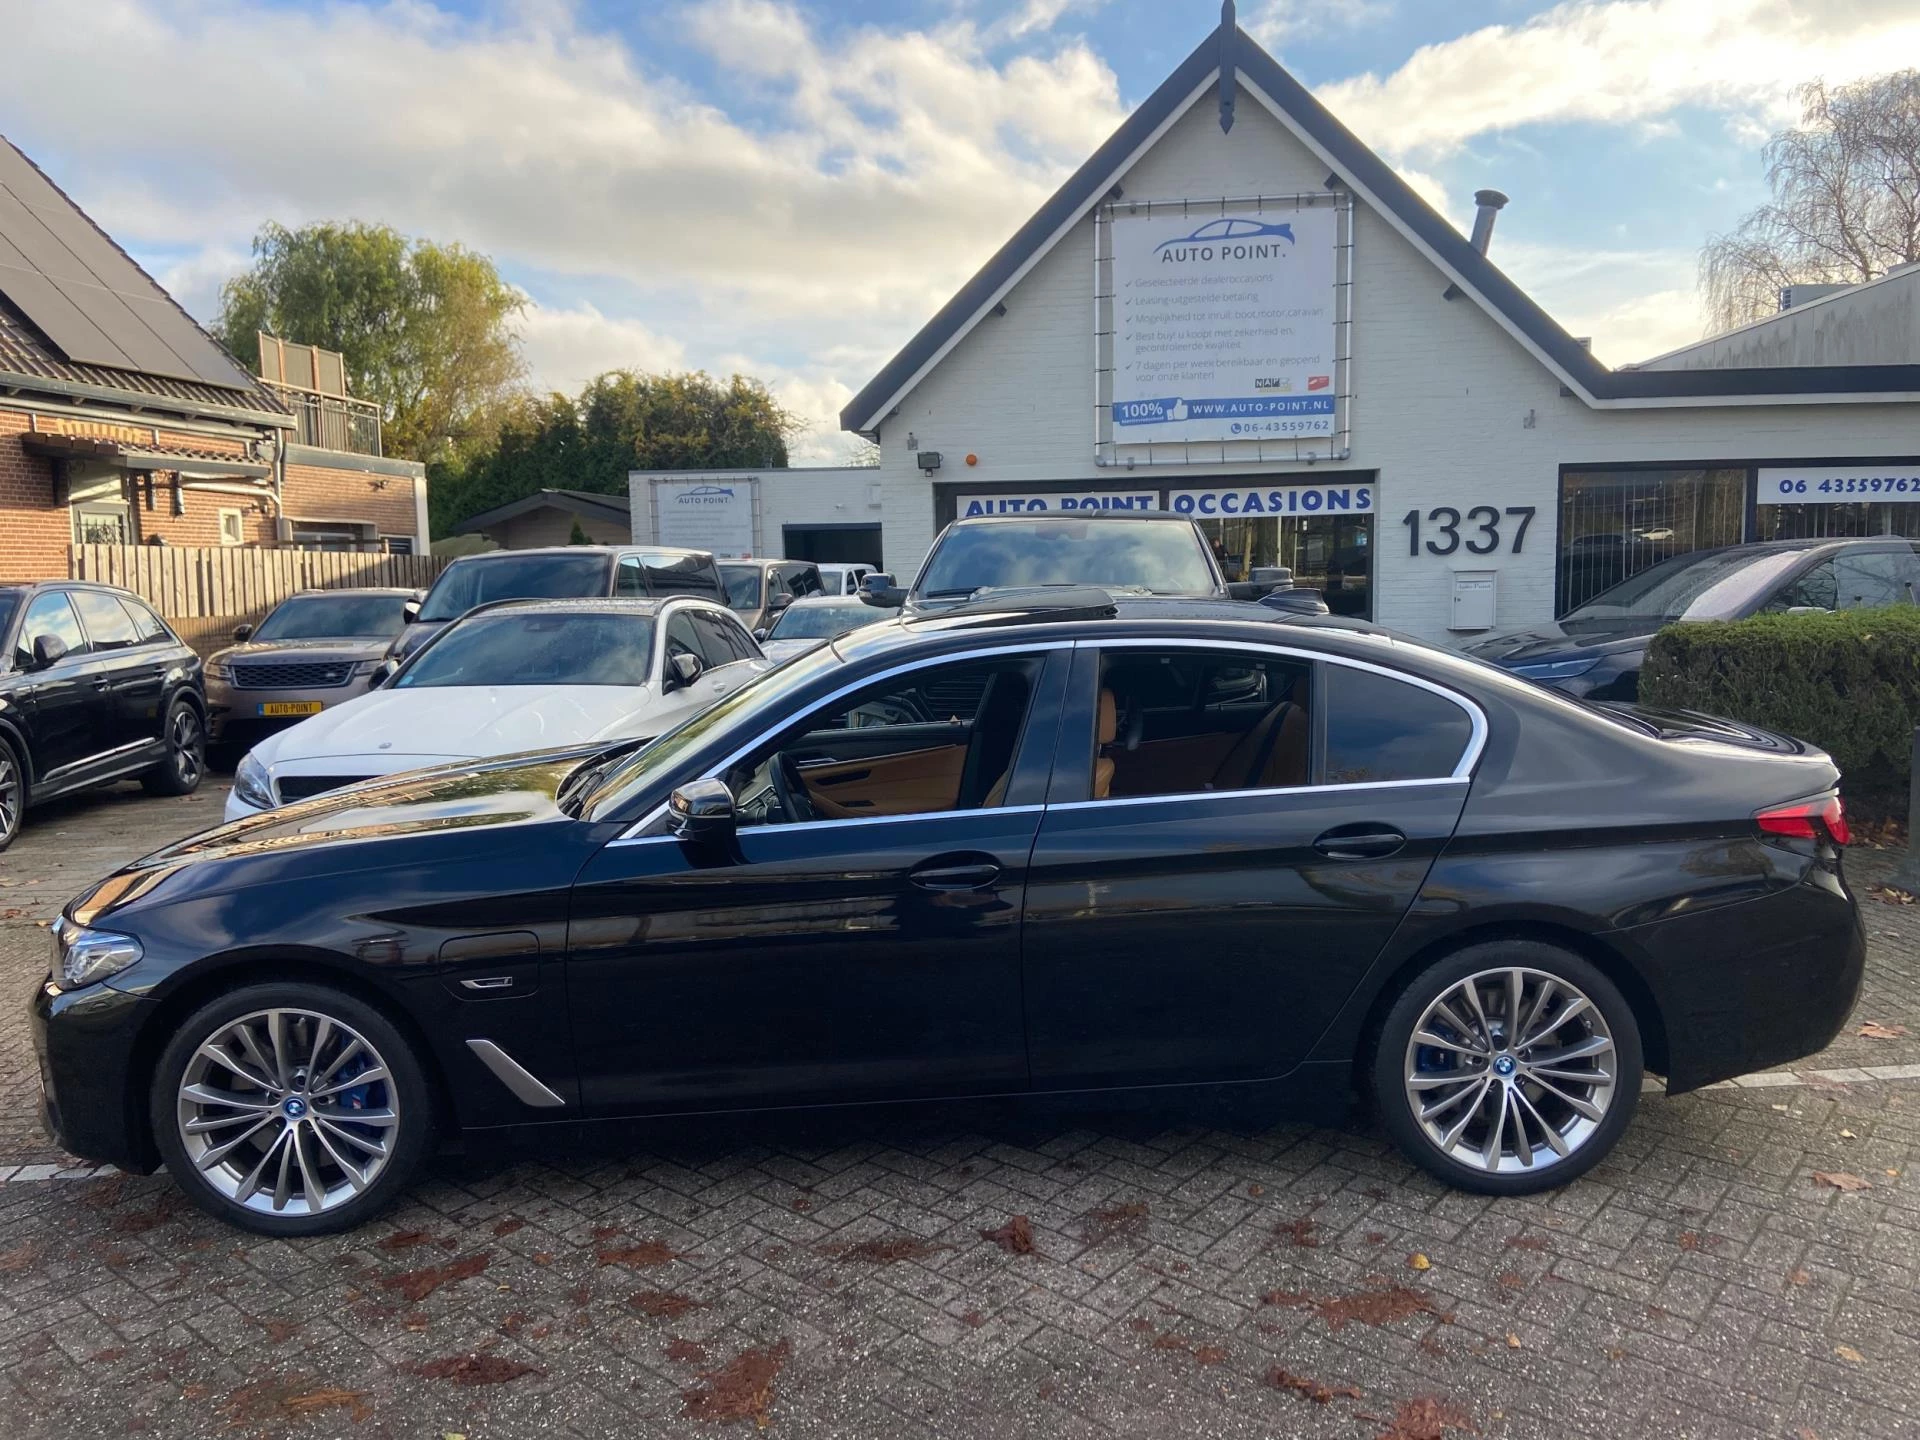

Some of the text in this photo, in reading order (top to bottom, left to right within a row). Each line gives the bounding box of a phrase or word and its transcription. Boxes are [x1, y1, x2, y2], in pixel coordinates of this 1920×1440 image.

[1162, 247, 1213, 264] AUTO
[1122, 402, 1163, 418] 100%
[1192, 400, 1330, 414] WWW.AUTO-POINT.NL
[1244, 420, 1329, 433] 06-43559762
[1779, 477, 1920, 494] 06 43559762
[1174, 488, 1371, 515] OCCASIONS
[1402, 505, 1536, 556] 1337
[270, 703, 313, 714] AUTO-POINT
